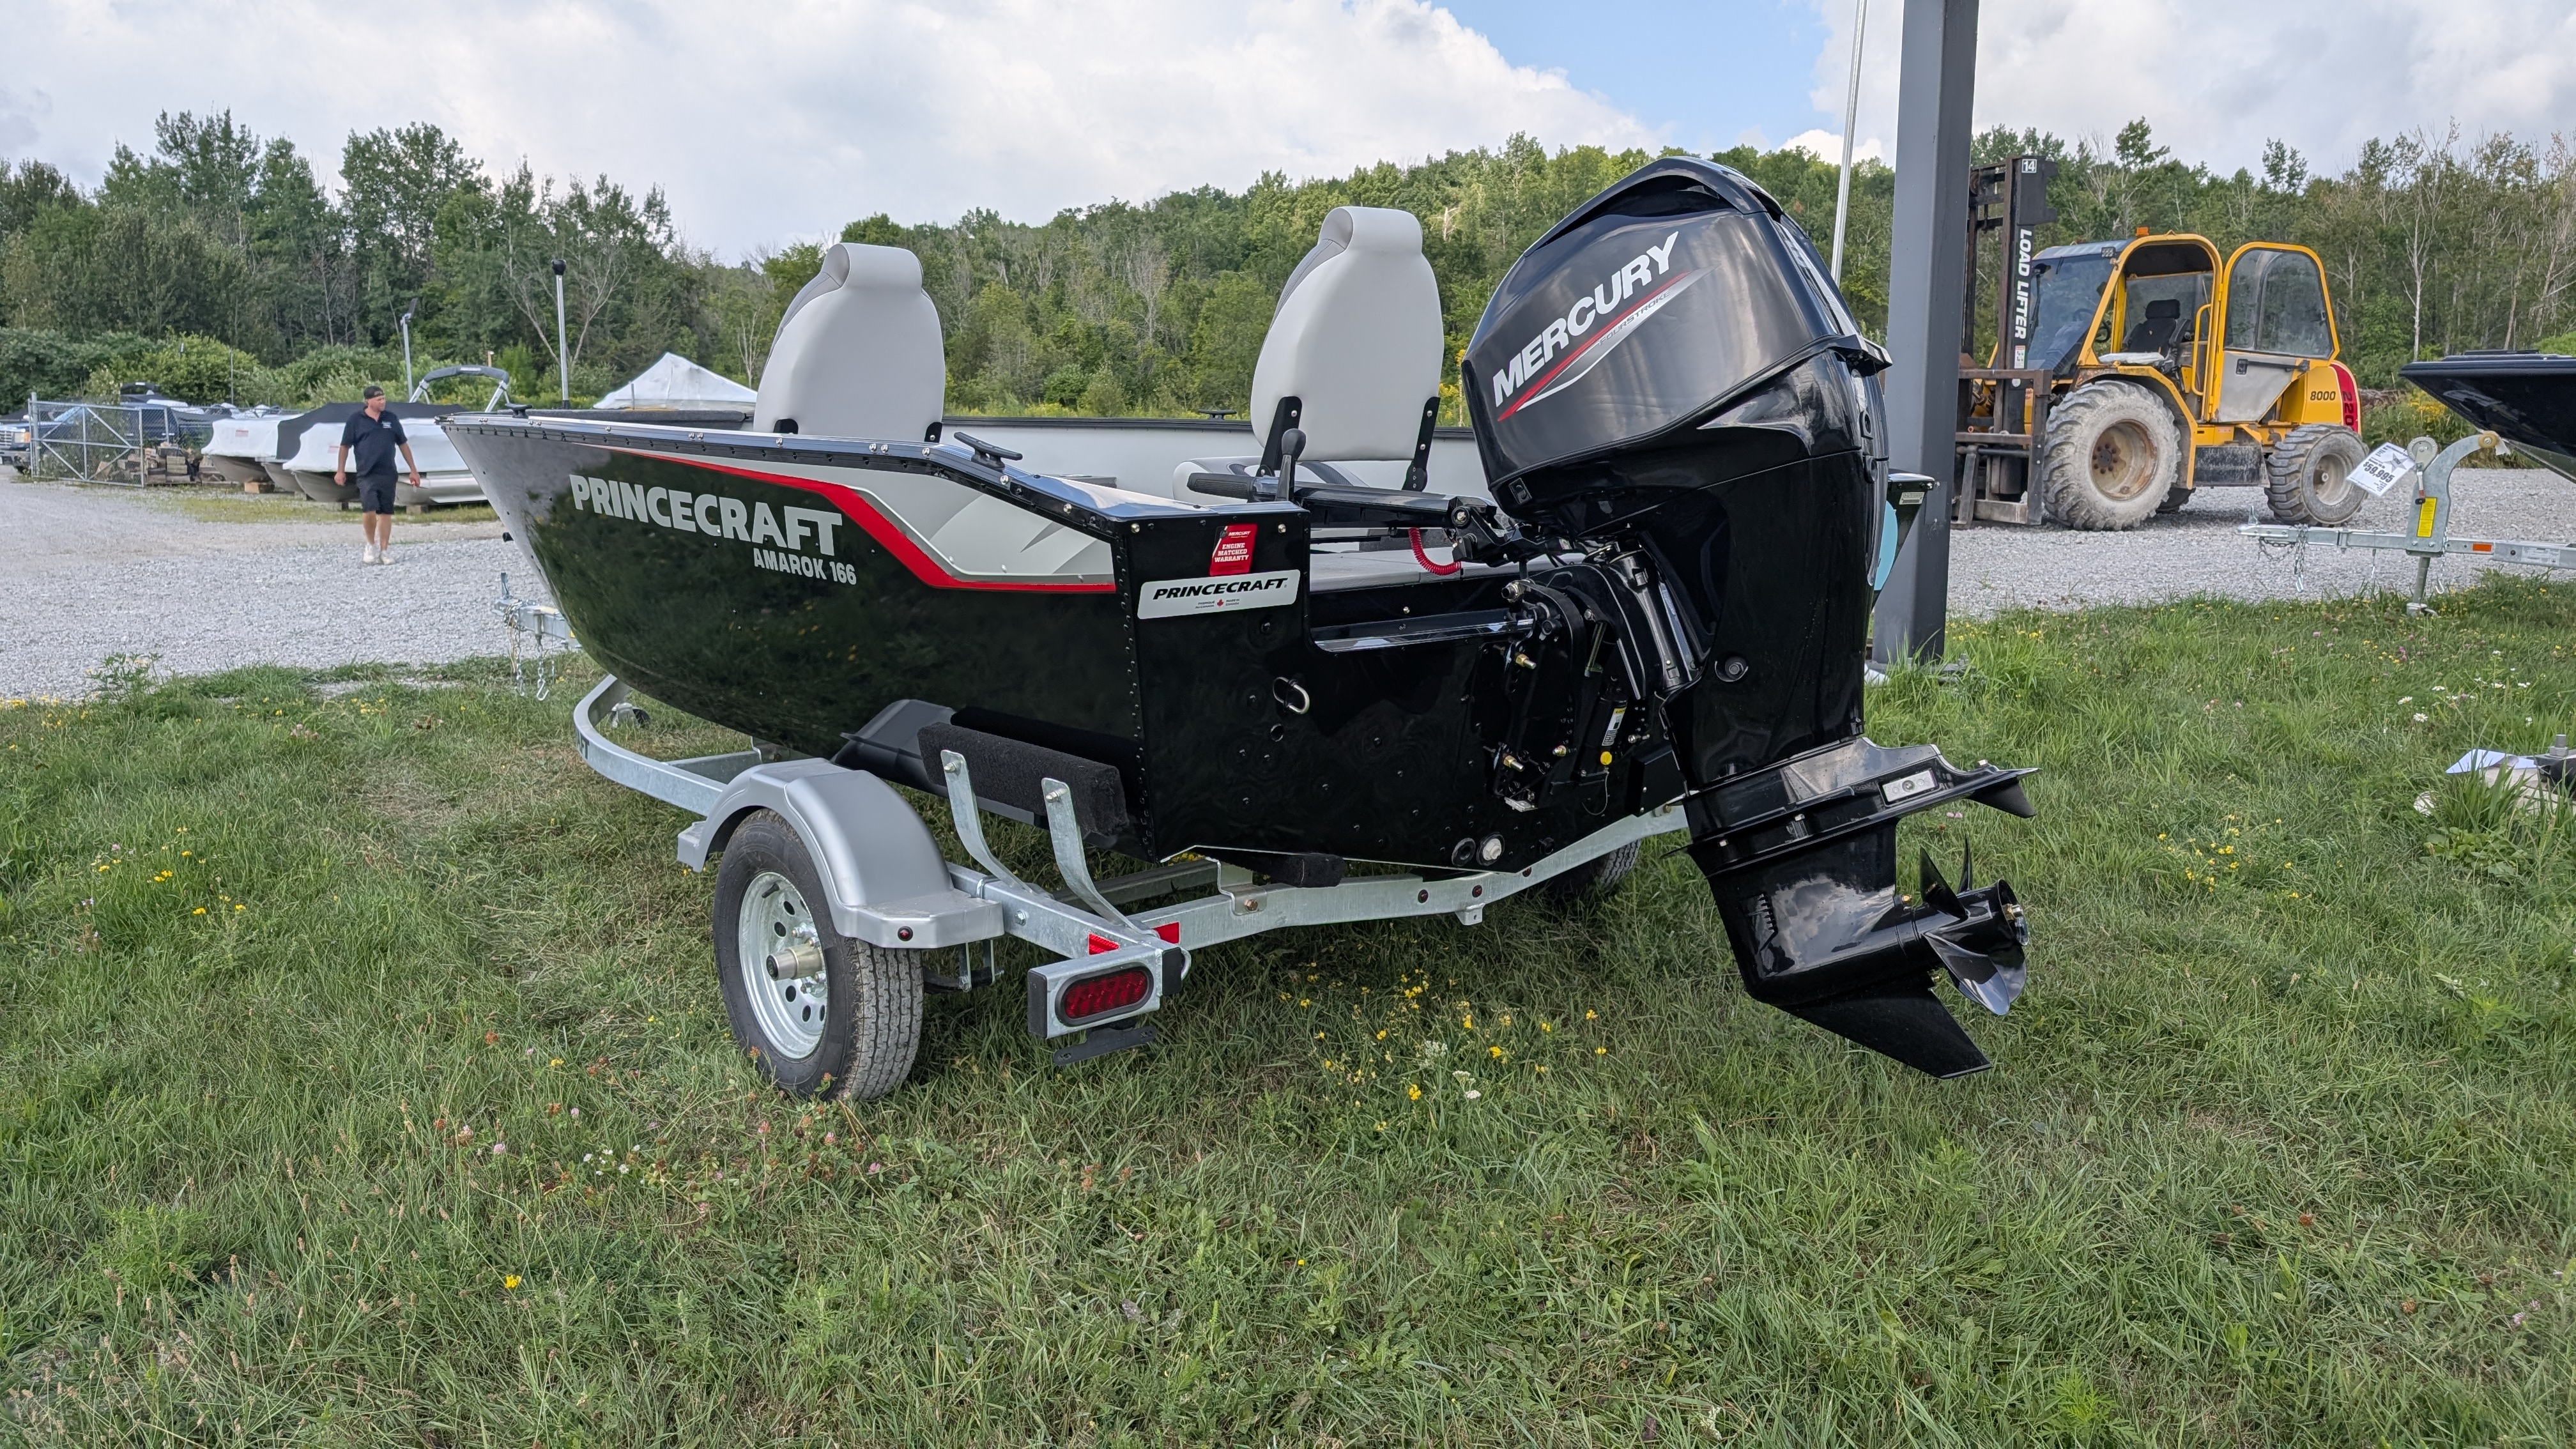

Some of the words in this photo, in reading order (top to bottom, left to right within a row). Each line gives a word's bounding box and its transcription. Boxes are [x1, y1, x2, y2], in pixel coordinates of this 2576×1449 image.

[2023, 160, 2035, 172] 14
[2018, 228, 2032, 277] LOAD
[1492, 231, 1678, 407] MERCURY
[1598, 290, 1670, 346] FOURSTROKE
[2015, 281, 2031, 339] LIFTER
[2310, 391, 2336, 401] 8000
[2363, 461, 2395, 483] $59,995
[569, 474, 842, 556] PRINCECRAFT
[753, 548, 827, 579] AMAROK
[829, 561, 857, 585] 166
[1153, 578, 1288, 600] PRINCECRAFT
